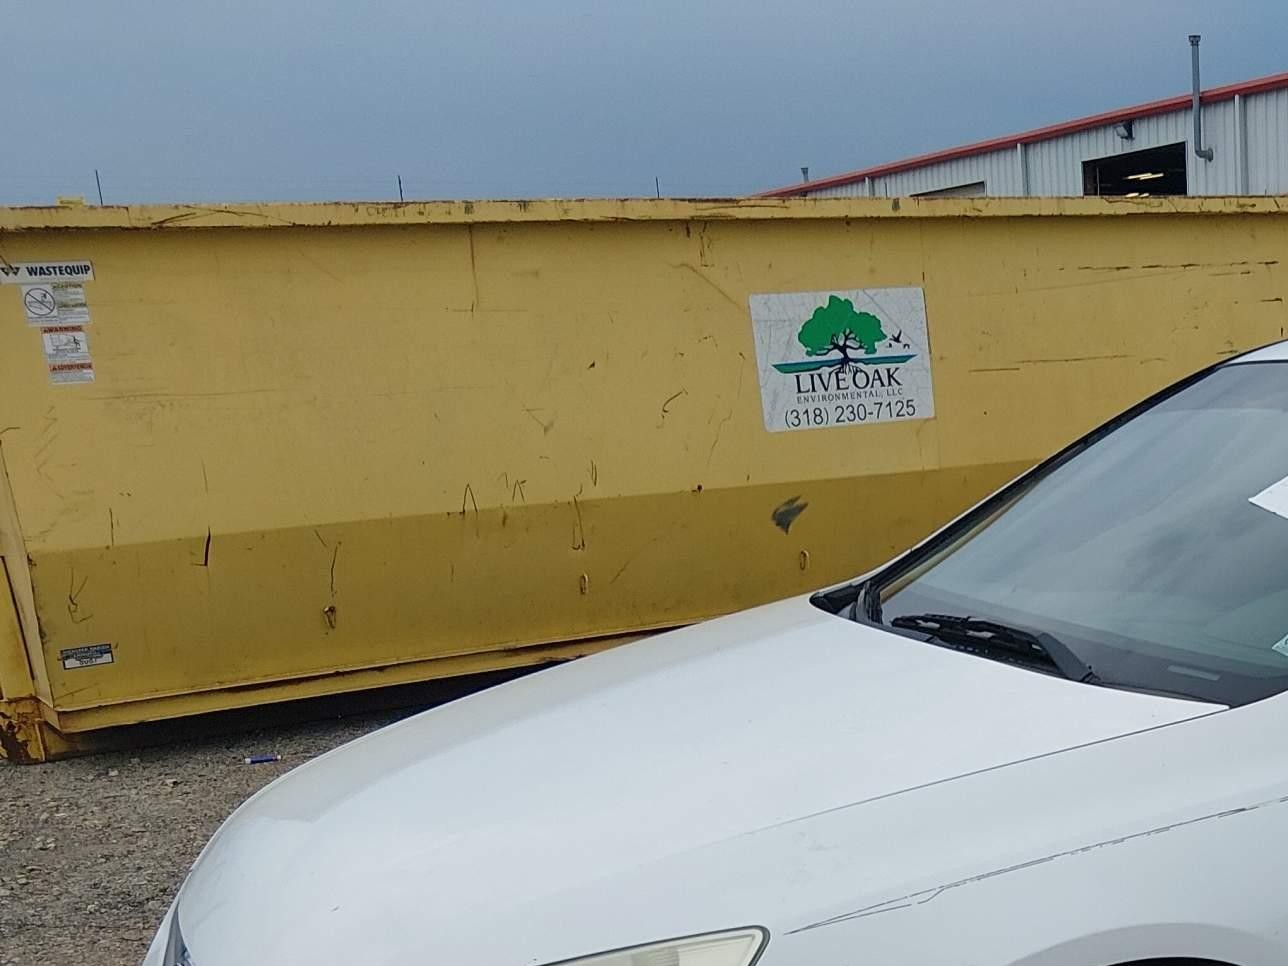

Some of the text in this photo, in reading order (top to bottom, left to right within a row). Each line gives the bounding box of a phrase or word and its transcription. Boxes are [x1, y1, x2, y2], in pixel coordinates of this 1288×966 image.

[26, 265, 91, 277] WASTEQUIP
[795, 367, 903, 394] LIVE OAK
[797, 387, 903, 404] ENVIRONMENTAL, LLC
[785, 399, 916, 428] (318) 230-7125
